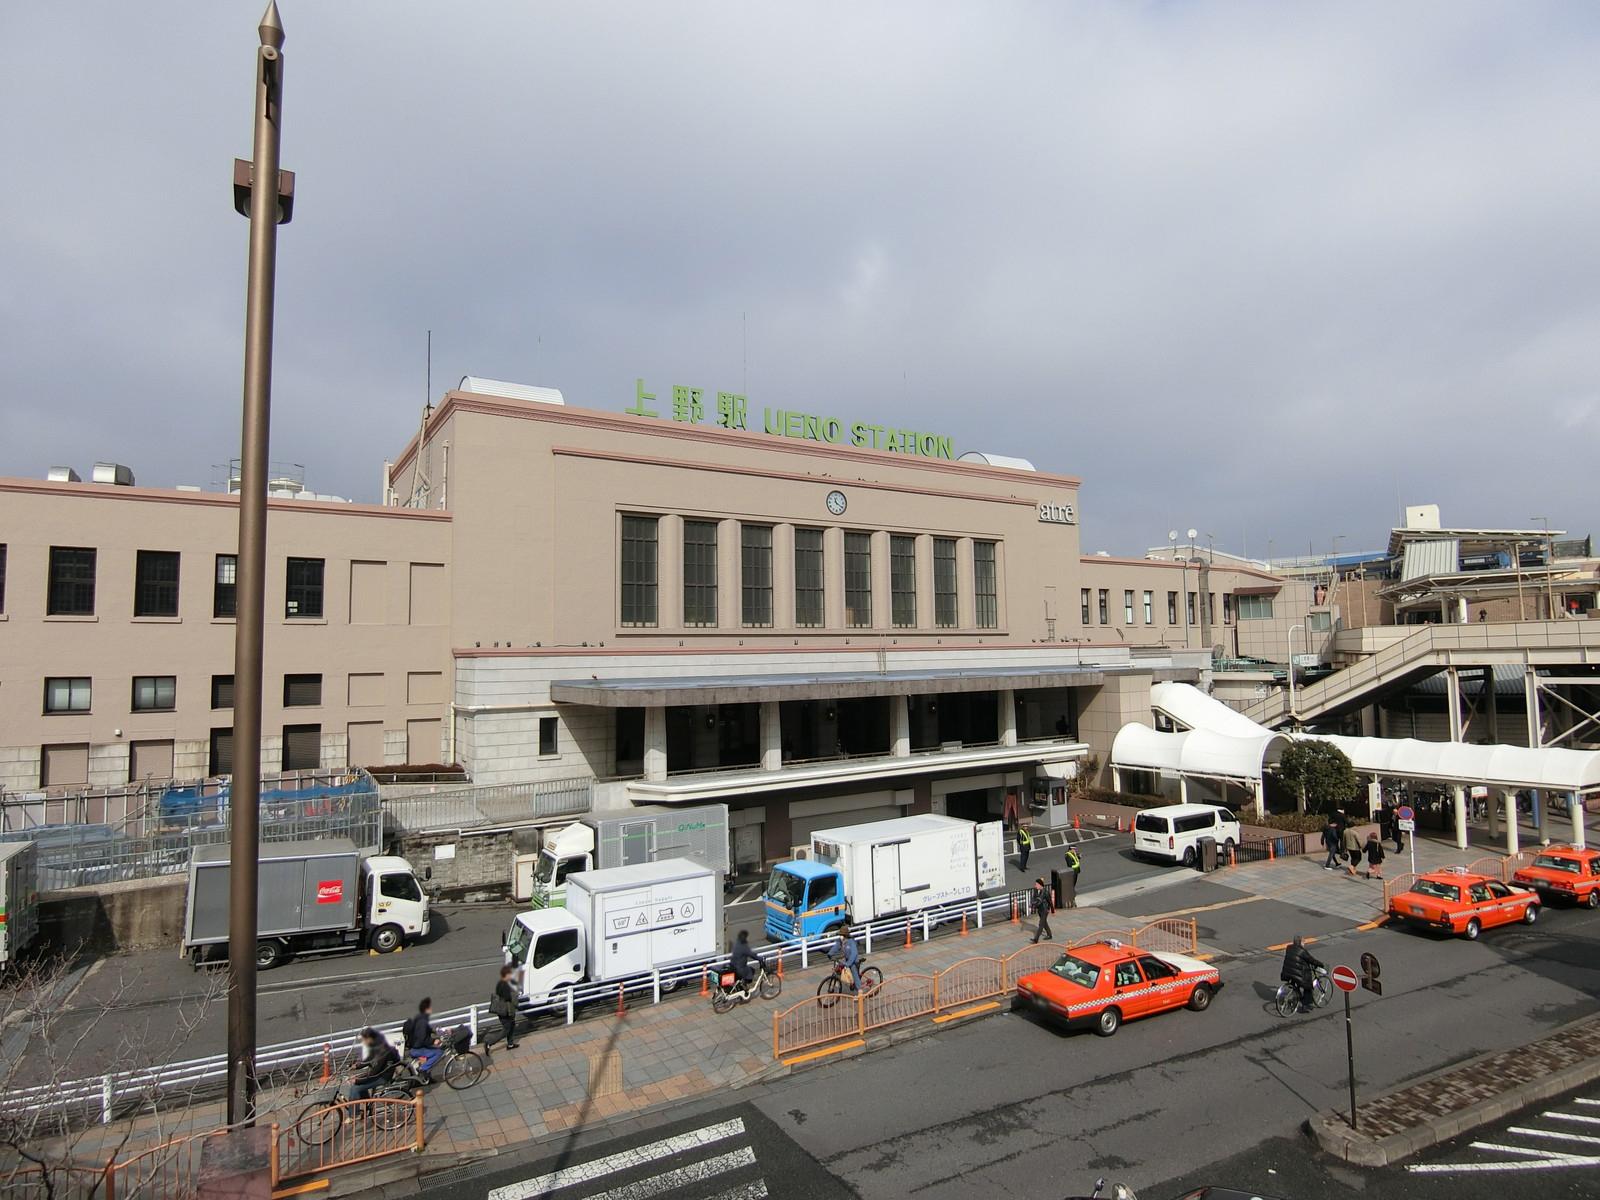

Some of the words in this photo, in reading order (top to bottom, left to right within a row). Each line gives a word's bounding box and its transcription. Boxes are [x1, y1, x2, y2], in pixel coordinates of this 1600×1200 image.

[625, 378, 748, 430] 上野駅
[764, 407, 844, 444] UENO
[851, 421, 955, 460] STATION
[1040, 502, 1074, 522] atré
